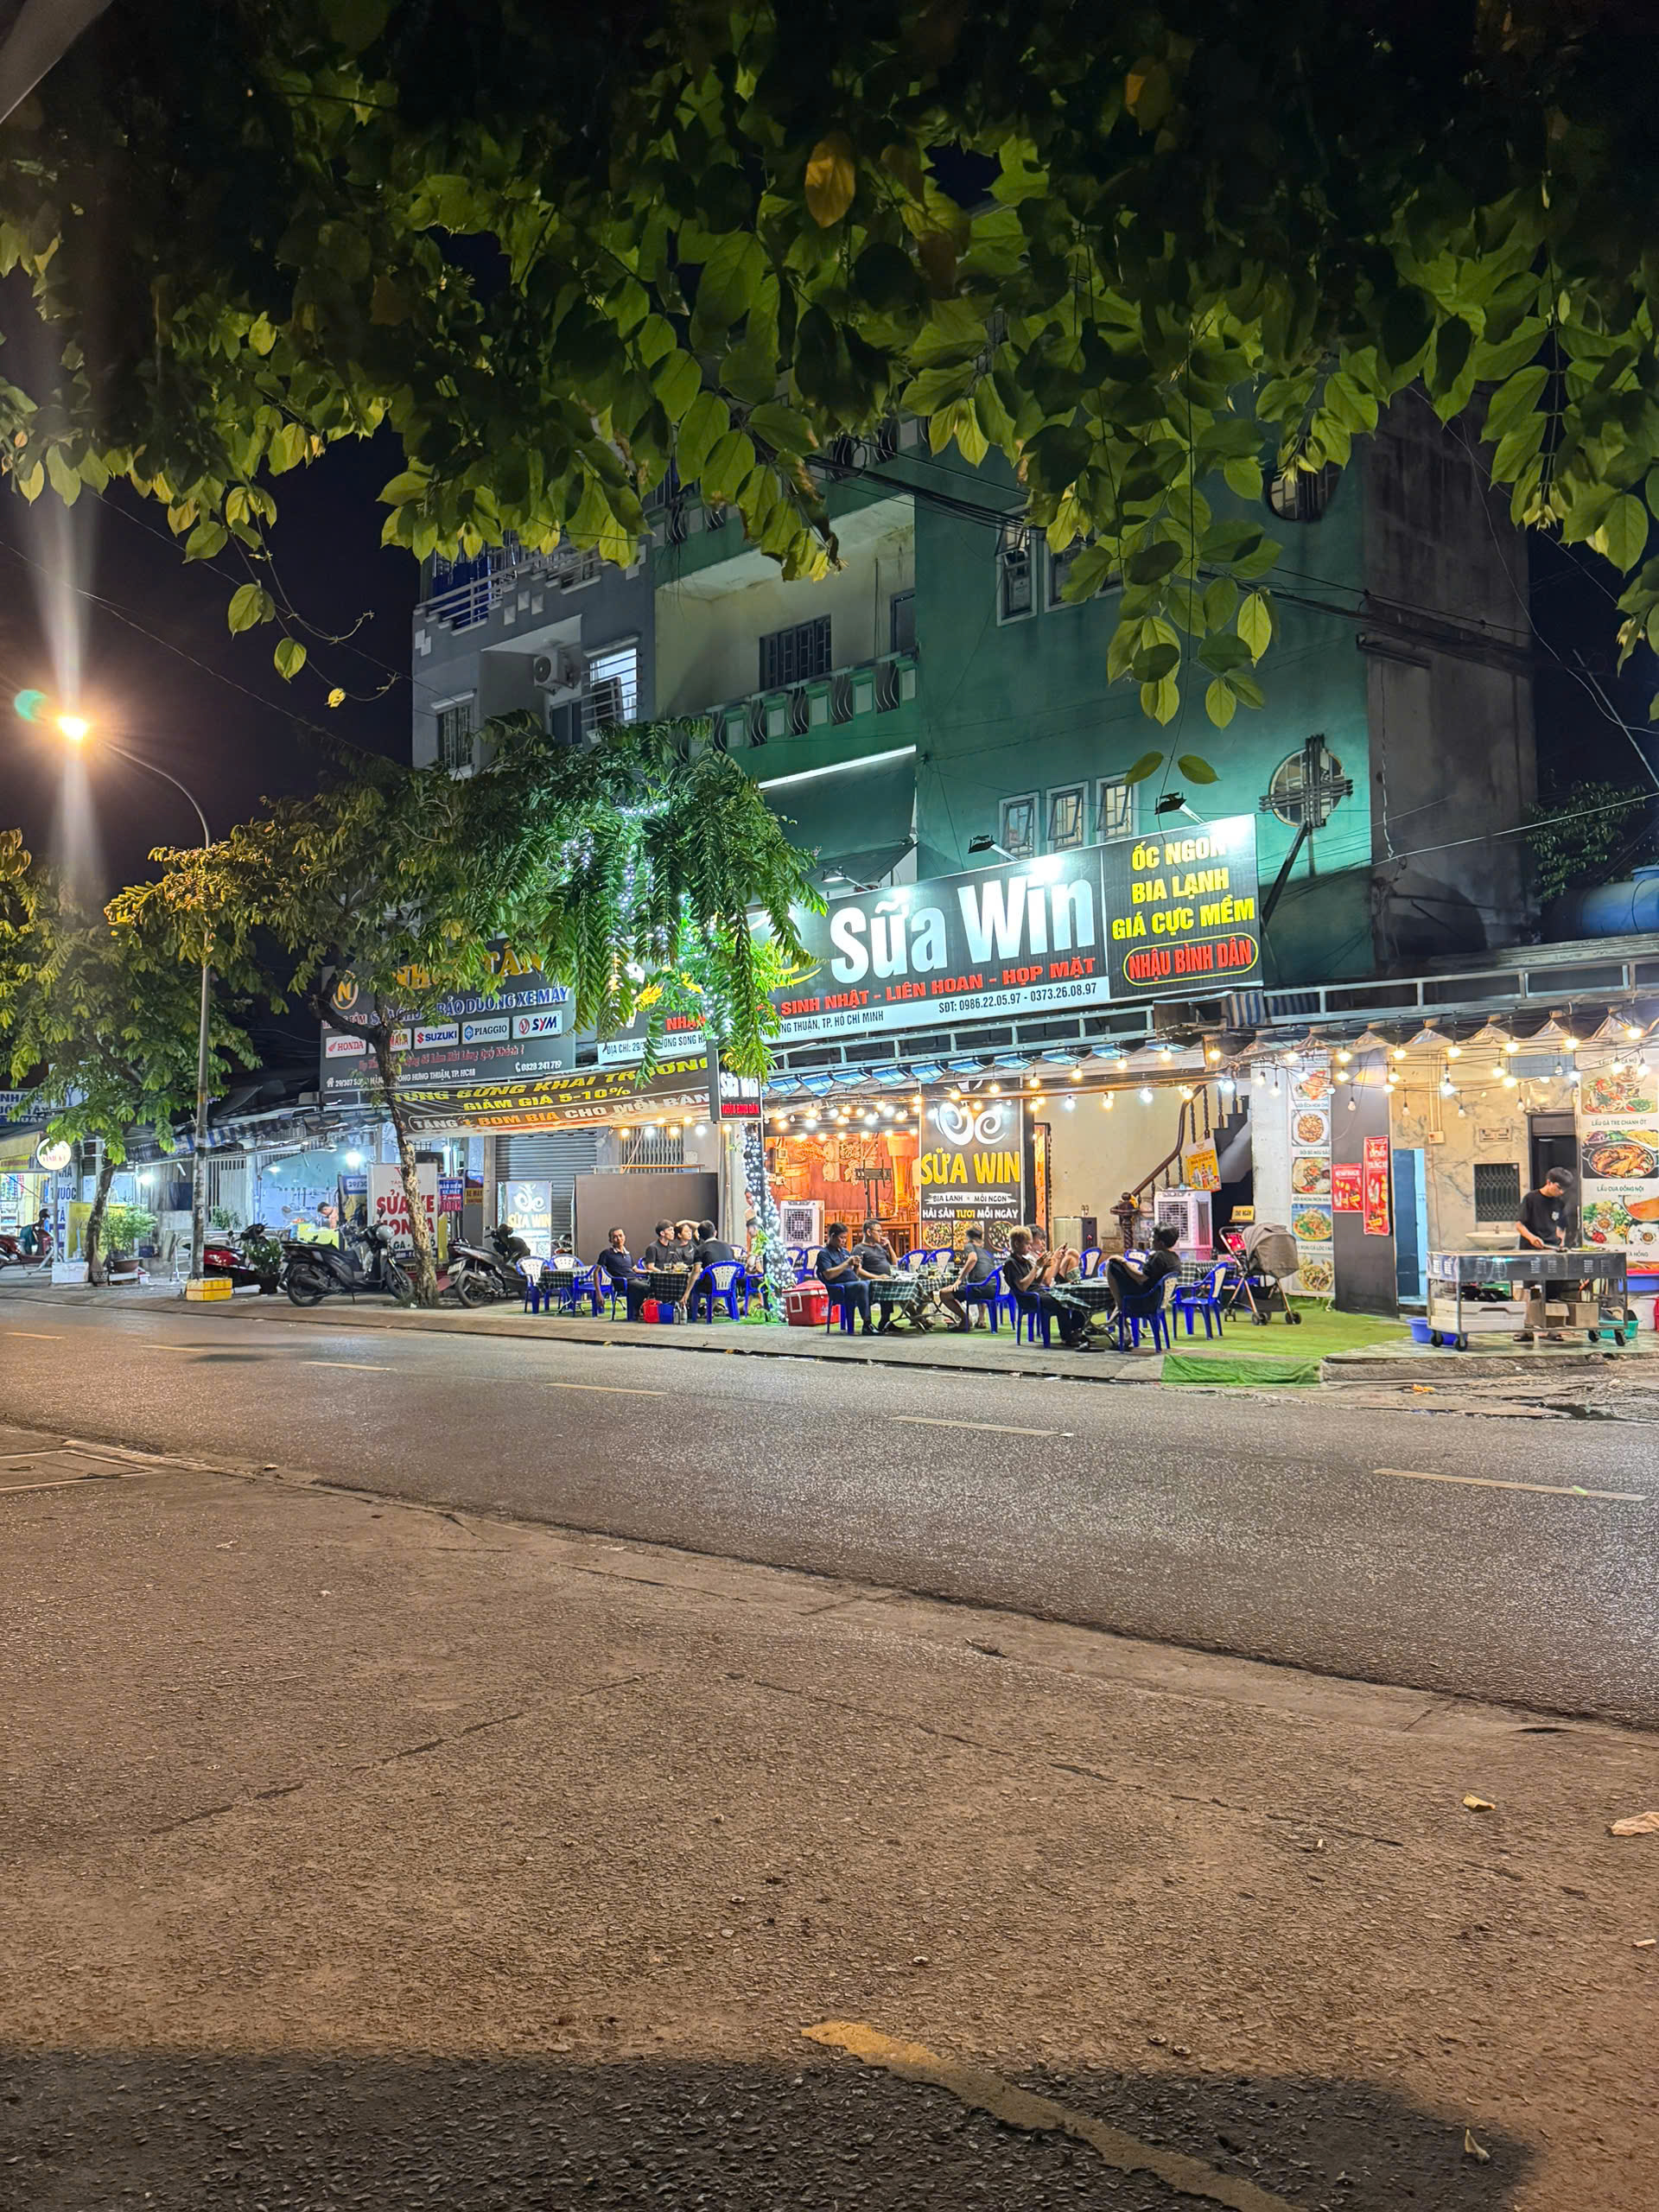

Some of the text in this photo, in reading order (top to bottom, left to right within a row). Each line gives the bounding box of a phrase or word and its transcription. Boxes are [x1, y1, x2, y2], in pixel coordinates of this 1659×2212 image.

[1132, 836, 1227, 870] ỐC NGON
[1132, 868, 1230, 904] BIA LẠNH
[830, 875, 1096, 984] Sữa Win
[1112, 894, 1255, 940] GIÁ CỰC MỀM
[1128, 937, 1252, 982] NHẬU BÌNH DÂN
[518, 990, 537, 1007] XE
[537, 981, 570, 1005] MÁY
[781, 997, 820, 1016] SINH
[824, 989, 869, 1009] NHẬT
[886, 982, 925, 1001] LIÊN
[931, 974, 982, 995] HOAN
[1002, 966, 1044, 986] HỌP
[1050, 956, 1096, 979] MẶT
[938, 1001, 957, 1014] SĐT:
[959, 993, 1020, 1011] 0986.22.05.97
[1030, 982, 1096, 1002] 0373.26.08.97
[337, 1041, 364, 1052] HONDA
[425, 1031, 457, 1042] SUZUKI
[474, 1025, 507, 1036] PIAGGIO
[531, 1016, 557, 1031] SYM
[822, 1018, 832, 1028] TP.
[847, 1011, 860, 1025] CHÍ
[862, 1010, 884, 1023] MINH
[678, 1035, 696, 1046] SONG
[460, 1068, 475, 1077] HCM
[533, 1076, 596, 1092] KHAI
[463, 1086, 631, 1111] GIẢM GIÁ 5-10%
[478, 1115, 520, 1127] BOM
[525, 1111, 561, 1122] BIA
[564, 1106, 607, 1119] CHO
[921, 1147, 1020, 1185] SỮA WIN
[995, 1207, 1019, 1218] NGÀY
